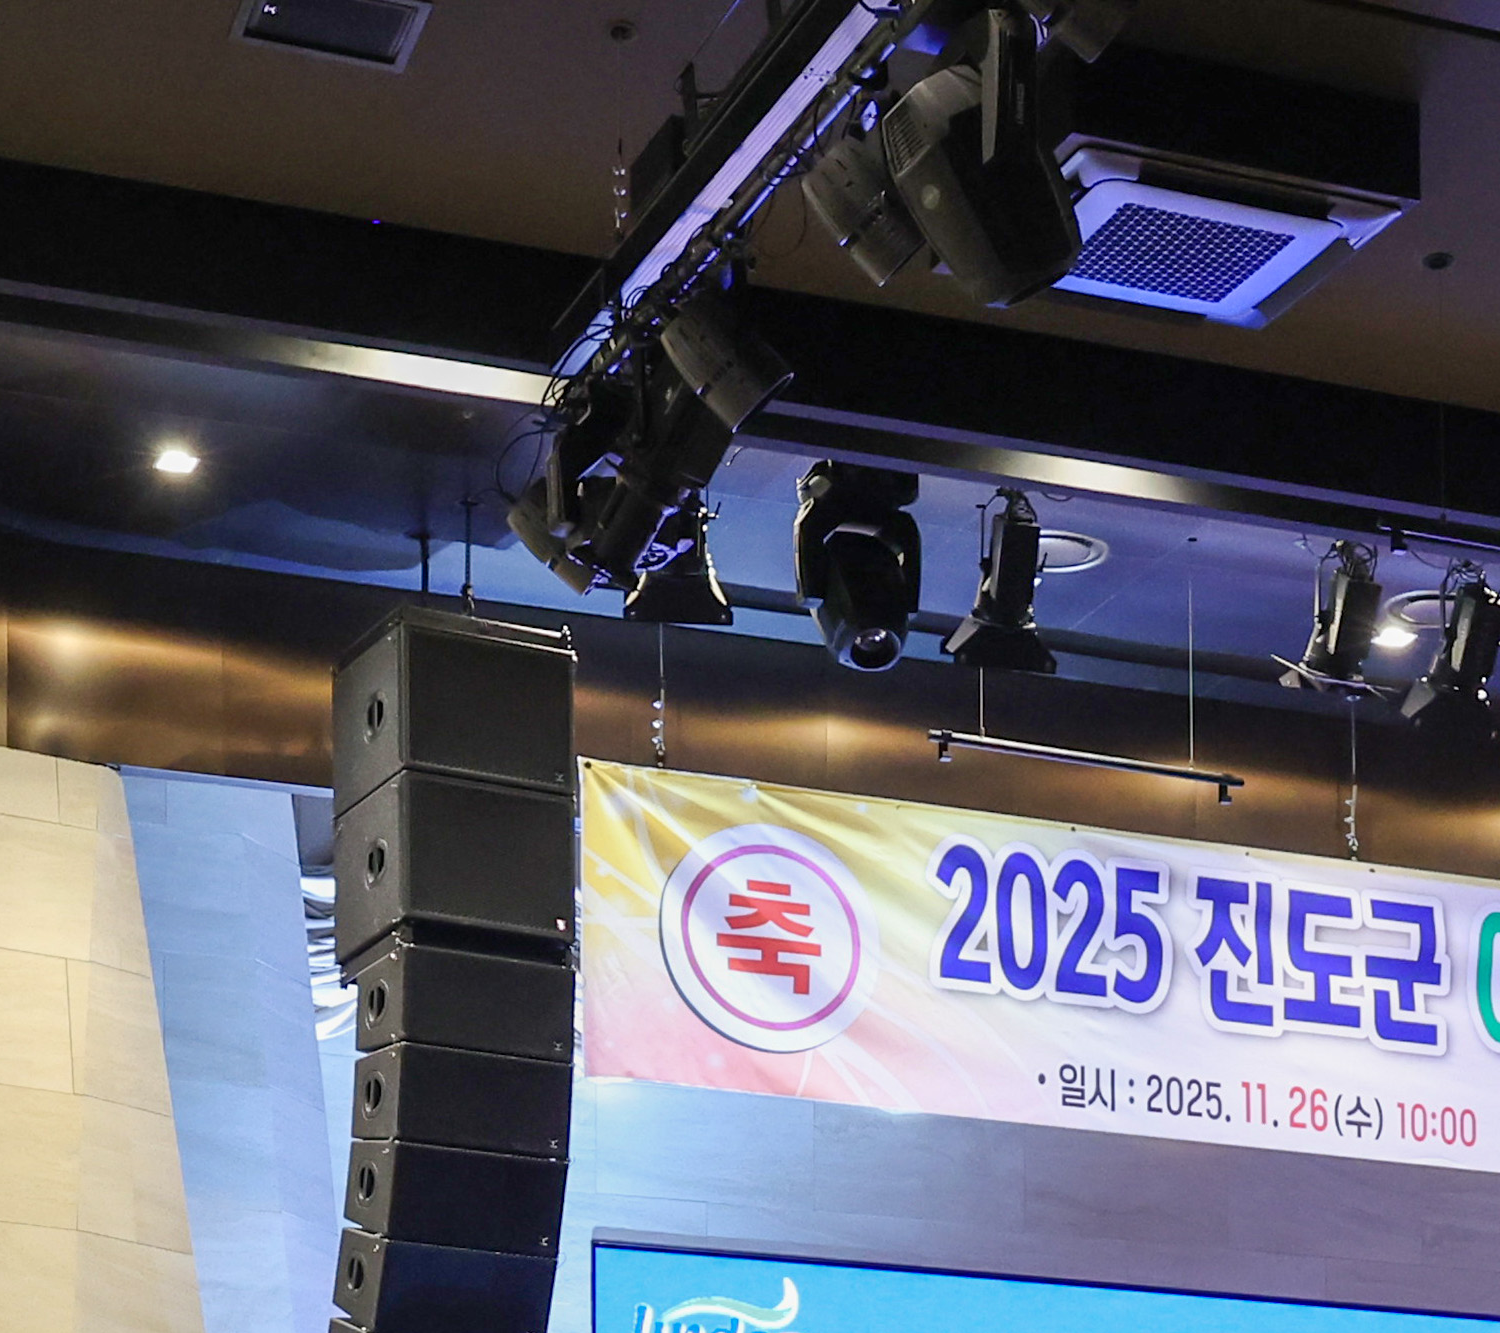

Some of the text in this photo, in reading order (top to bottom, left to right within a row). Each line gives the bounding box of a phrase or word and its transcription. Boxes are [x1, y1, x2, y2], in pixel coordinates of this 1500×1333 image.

[716, 880, 822, 995] 축
[935, 844, 1164, 1000] 2025
[1196, 877, 1443, 1047] 진도군
[1058, 1064, 1118, 1112] 일시
[1147, 1074, 1232, 1122] 2025.
[1396, 1103, 1477, 1148] 10:00
